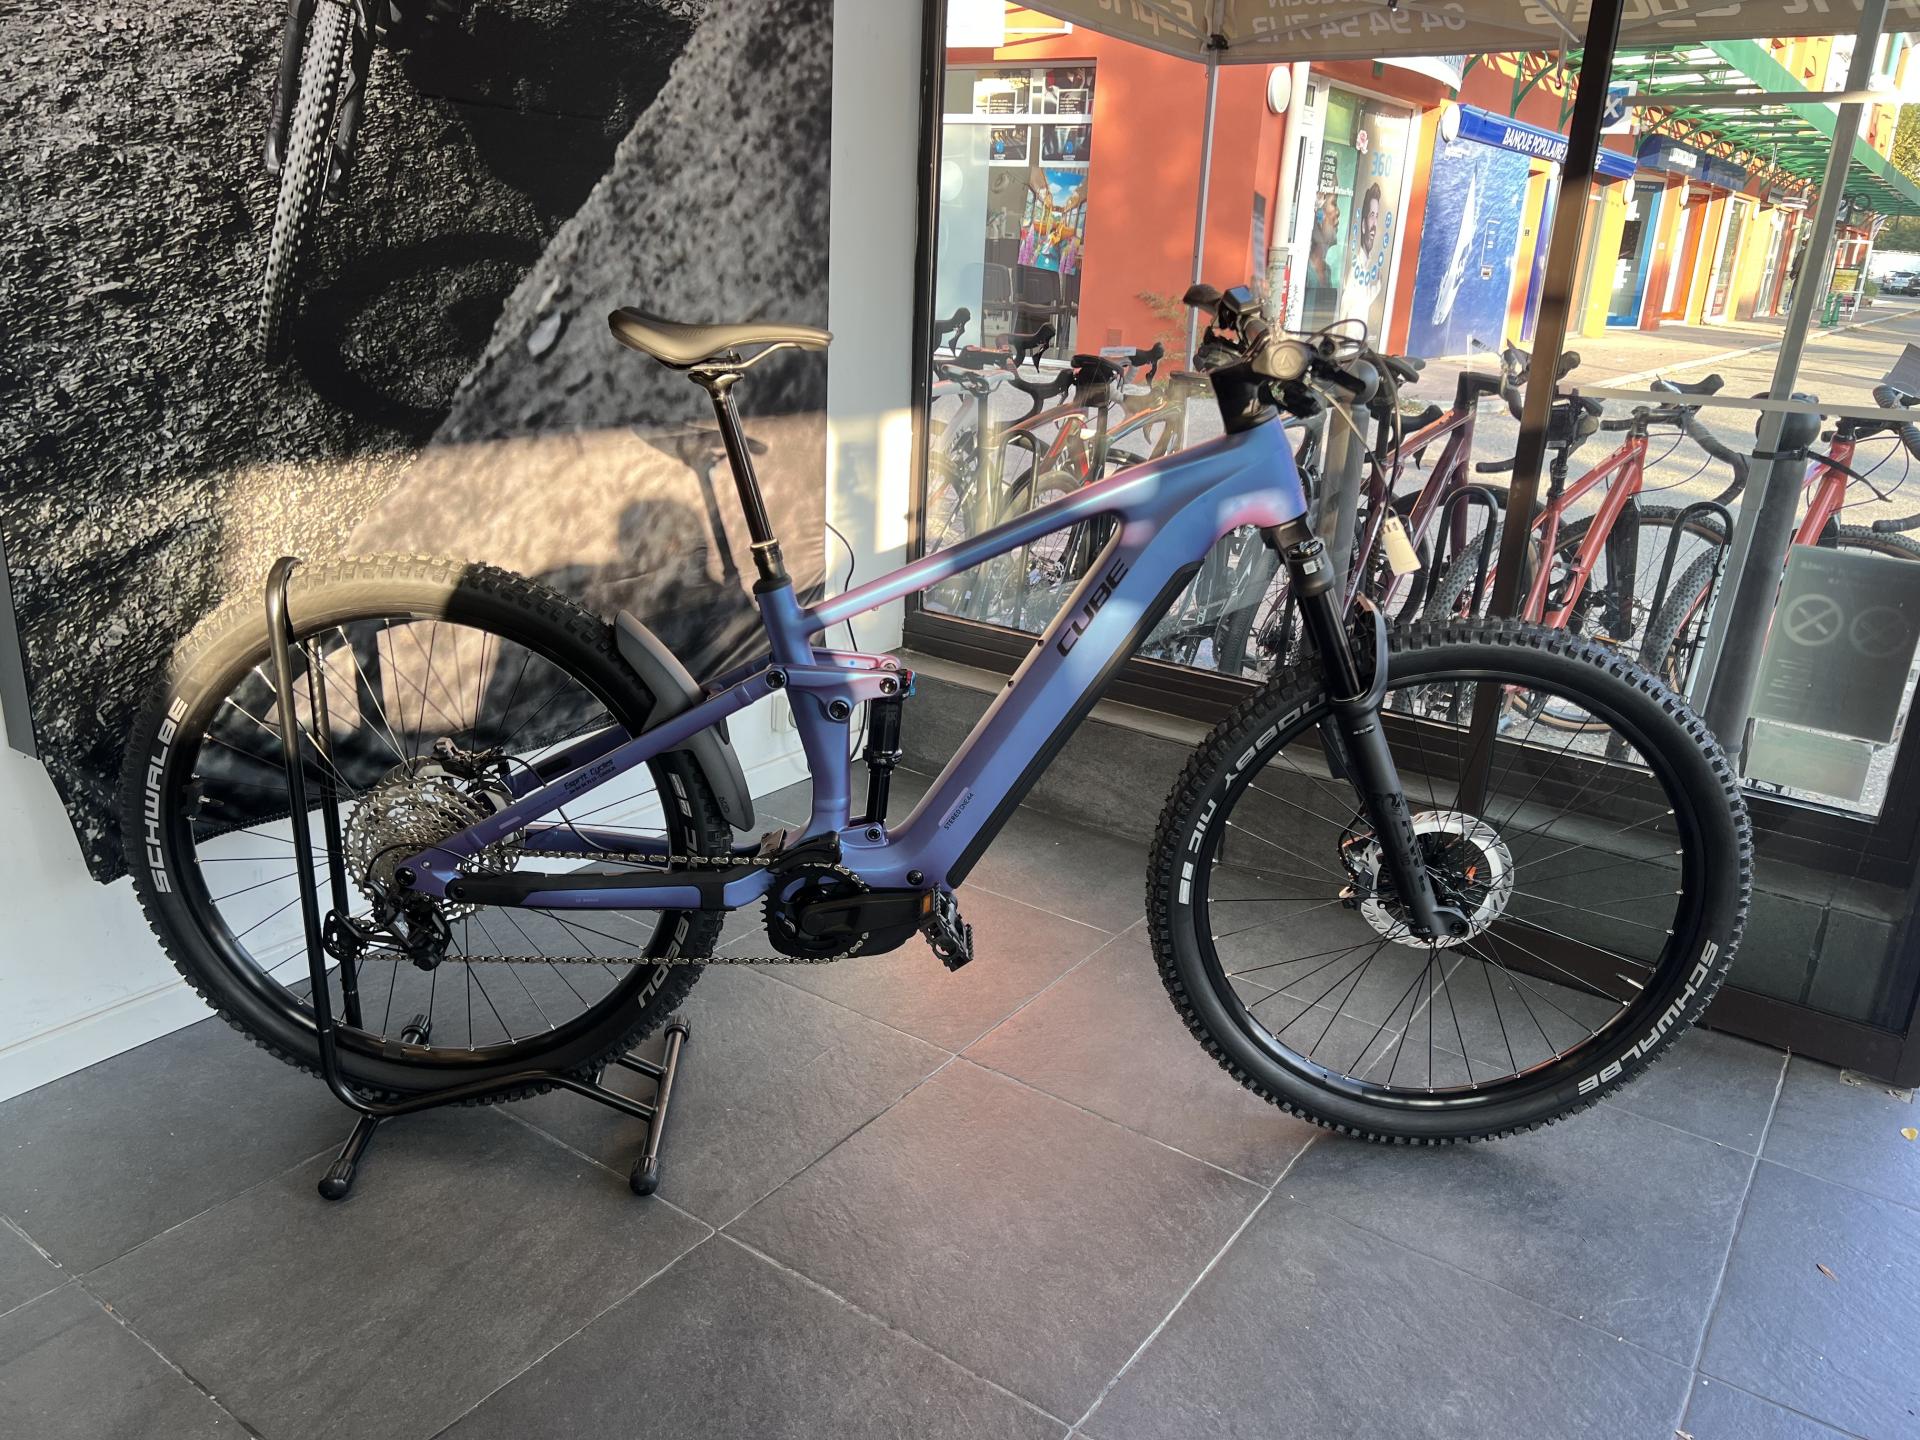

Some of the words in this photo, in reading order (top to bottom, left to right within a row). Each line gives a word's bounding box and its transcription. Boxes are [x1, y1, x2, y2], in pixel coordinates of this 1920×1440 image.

[1502, 127, 1534, 152] BANQUE
[1531, 133, 1567, 160] POPULAIRE
[1056, 557, 1129, 657] CUBE
[1225, 692, 1326, 792] NOBBY
[143, 696, 189, 894] SCHWALBE
[943, 809, 962, 831] STEREO
[1187, 799, 1218, 854] NIC
[1577, 939, 1719, 1096] SCHWALBE
